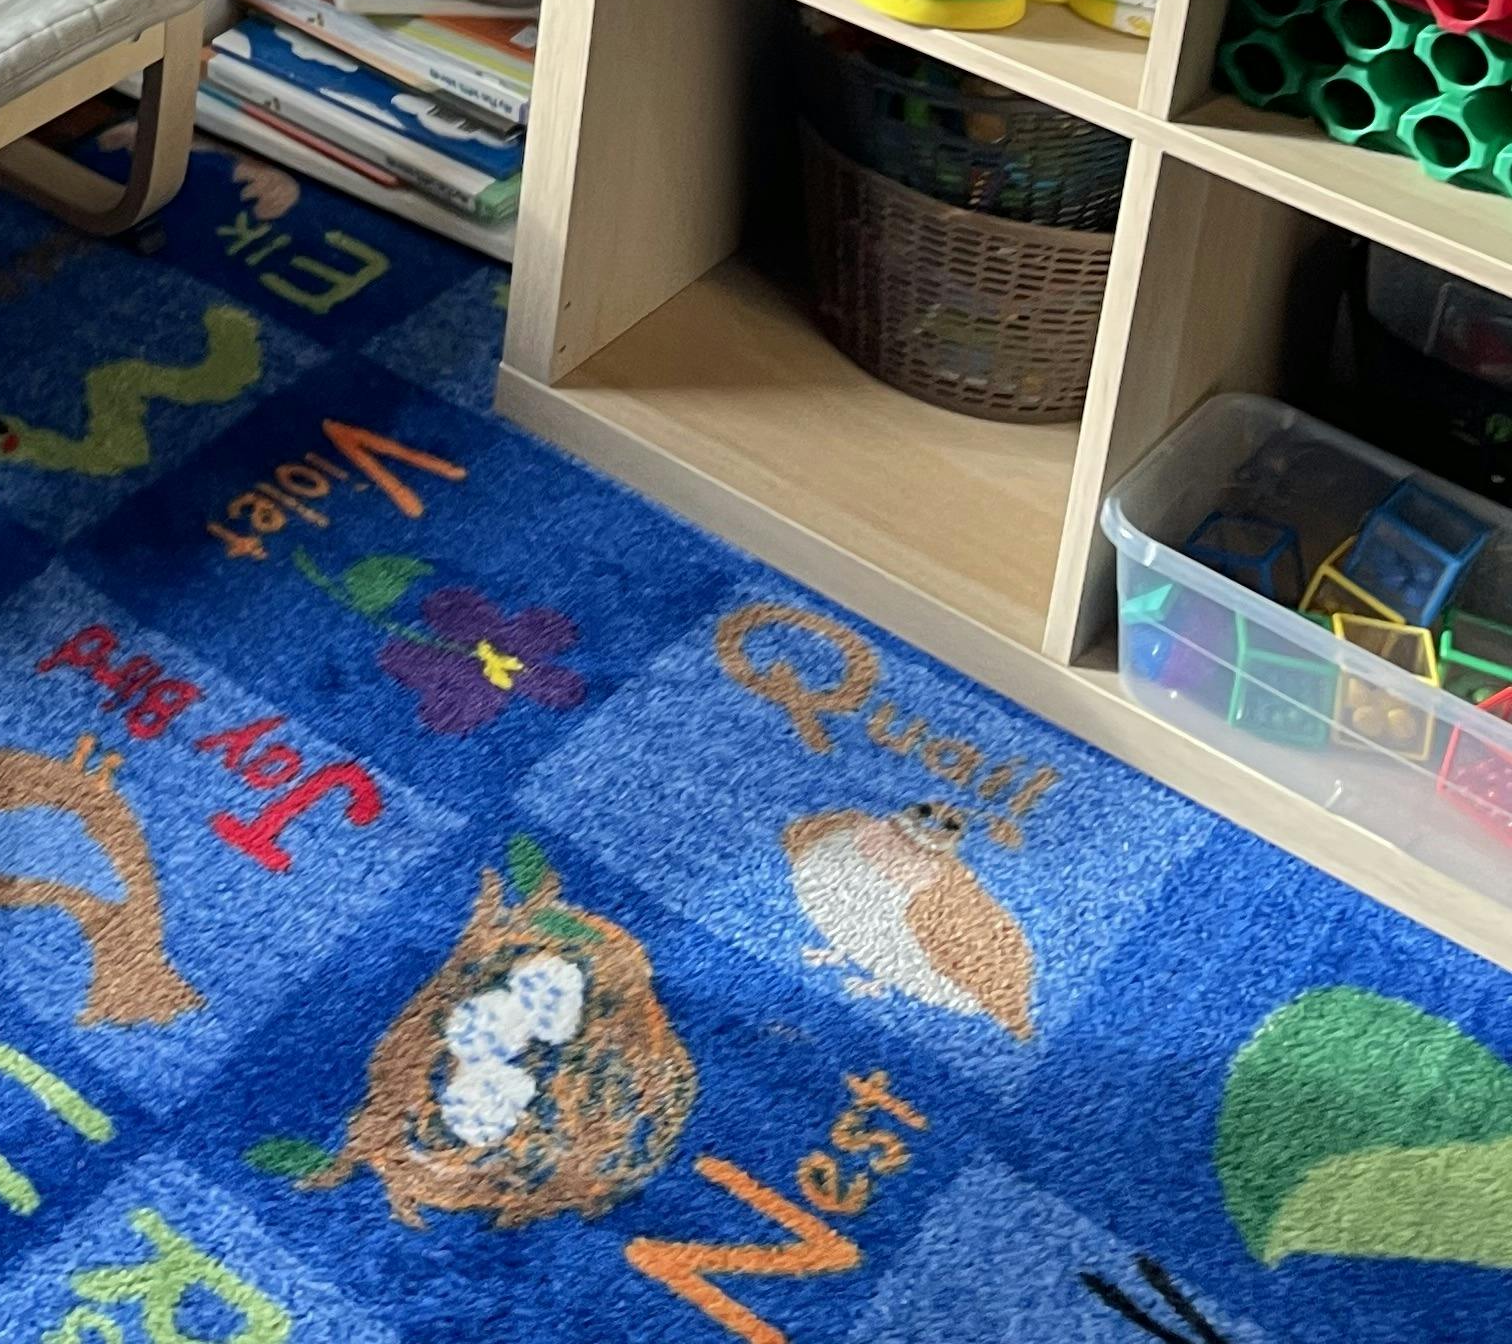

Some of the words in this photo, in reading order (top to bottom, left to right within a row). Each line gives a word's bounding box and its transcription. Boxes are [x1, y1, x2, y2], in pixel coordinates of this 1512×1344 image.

[214, 209, 392, 315] Elk
[204, 414, 469, 566] Violet
[34, 621, 204, 743] Bird
[714, 600, 1064, 854] Quail
[193, 712, 386, 876] Jay
[623, 1068, 932, 1344] Nest
